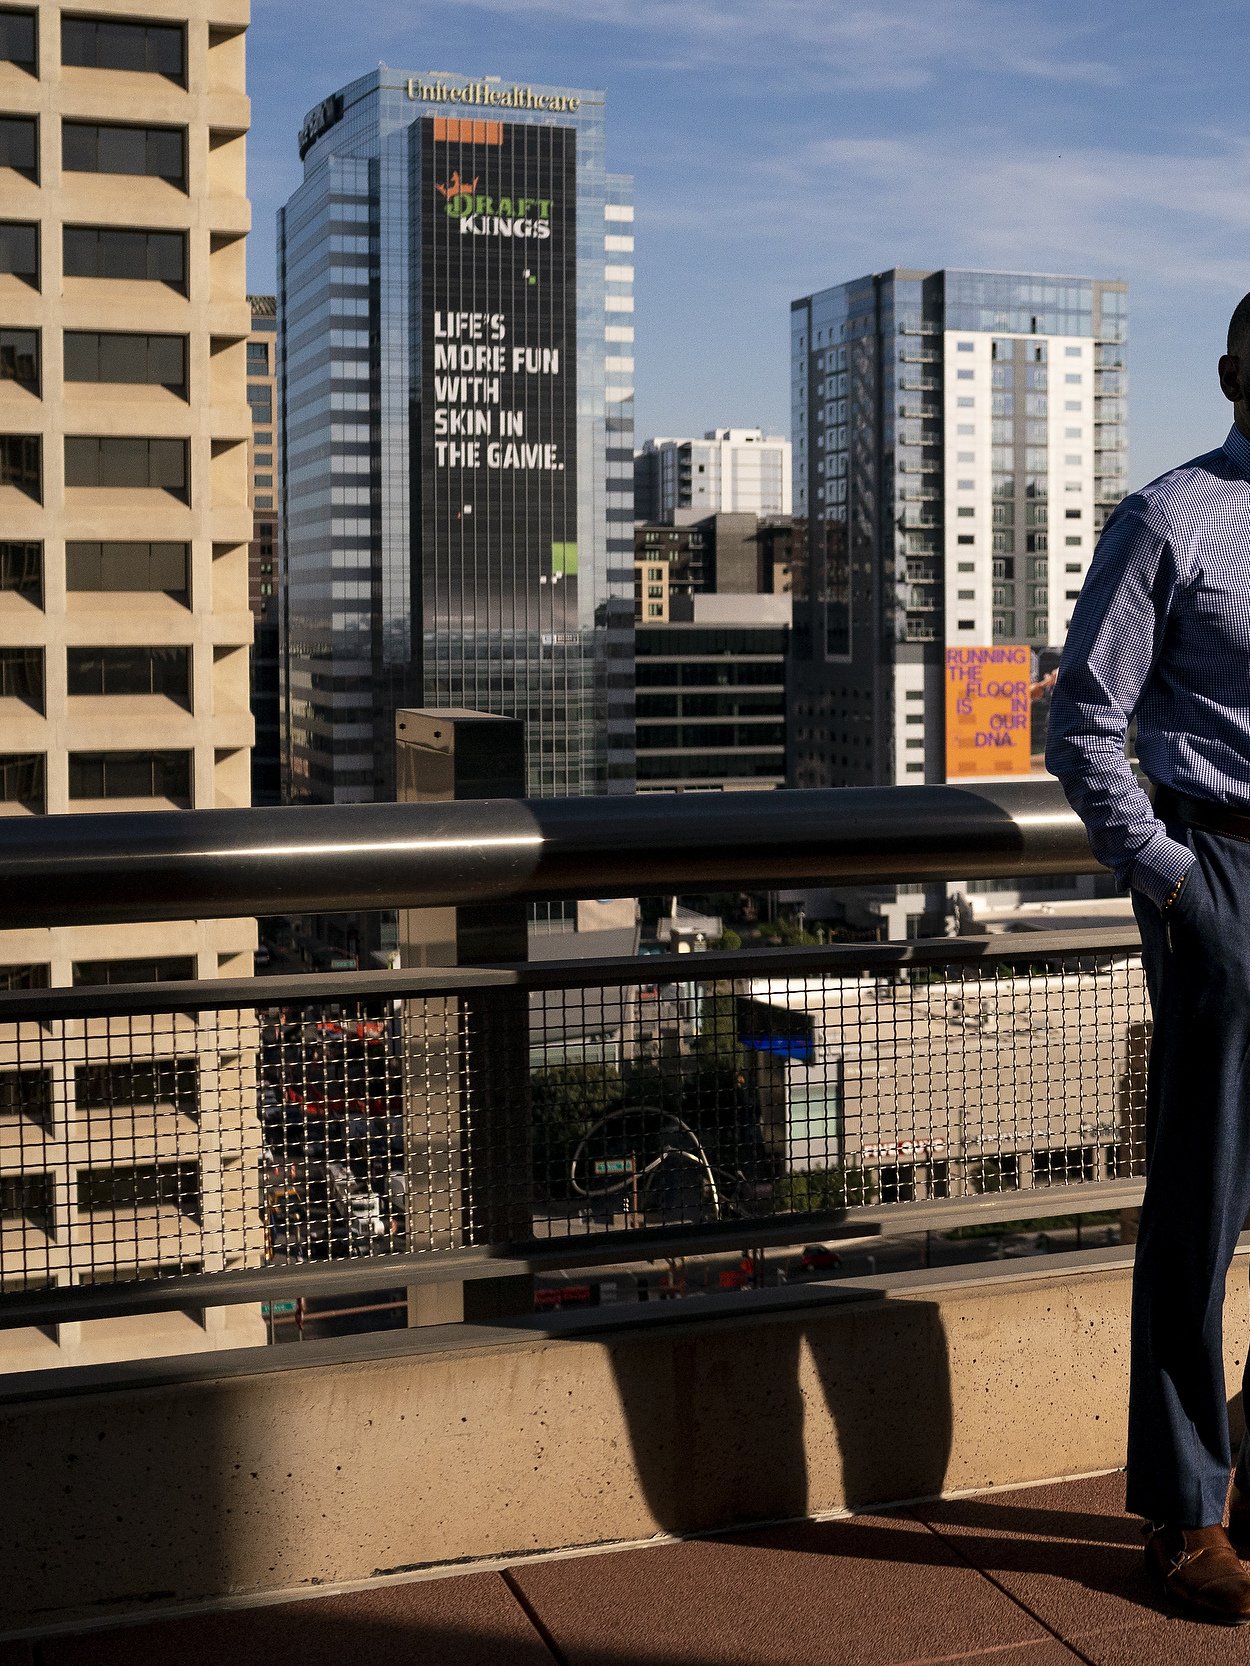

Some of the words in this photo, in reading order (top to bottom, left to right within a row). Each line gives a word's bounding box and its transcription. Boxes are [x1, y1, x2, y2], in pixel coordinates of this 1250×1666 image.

[406, 78, 580, 113] UnitedHealthcare
[445, 193, 554, 219] DRAFT
[459, 214, 551, 239] KINGS
[434, 344, 506, 372] MORE
[513, 347, 559, 374] FUN
[434, 376, 499, 403] WITH
[434, 409, 491, 436] SKIN
[500, 410, 523, 437] IN
[435, 441, 480, 468] THE
[487, 442, 564, 470] GAME.
[946, 648, 1026, 664] RUNNING
[949, 665, 982, 681] THE
[966, 681, 1027, 697] FLOOR
[957, 700, 972, 715] IS
[1011, 698, 1027, 713] IN
[990, 714, 1026, 730] OUR
